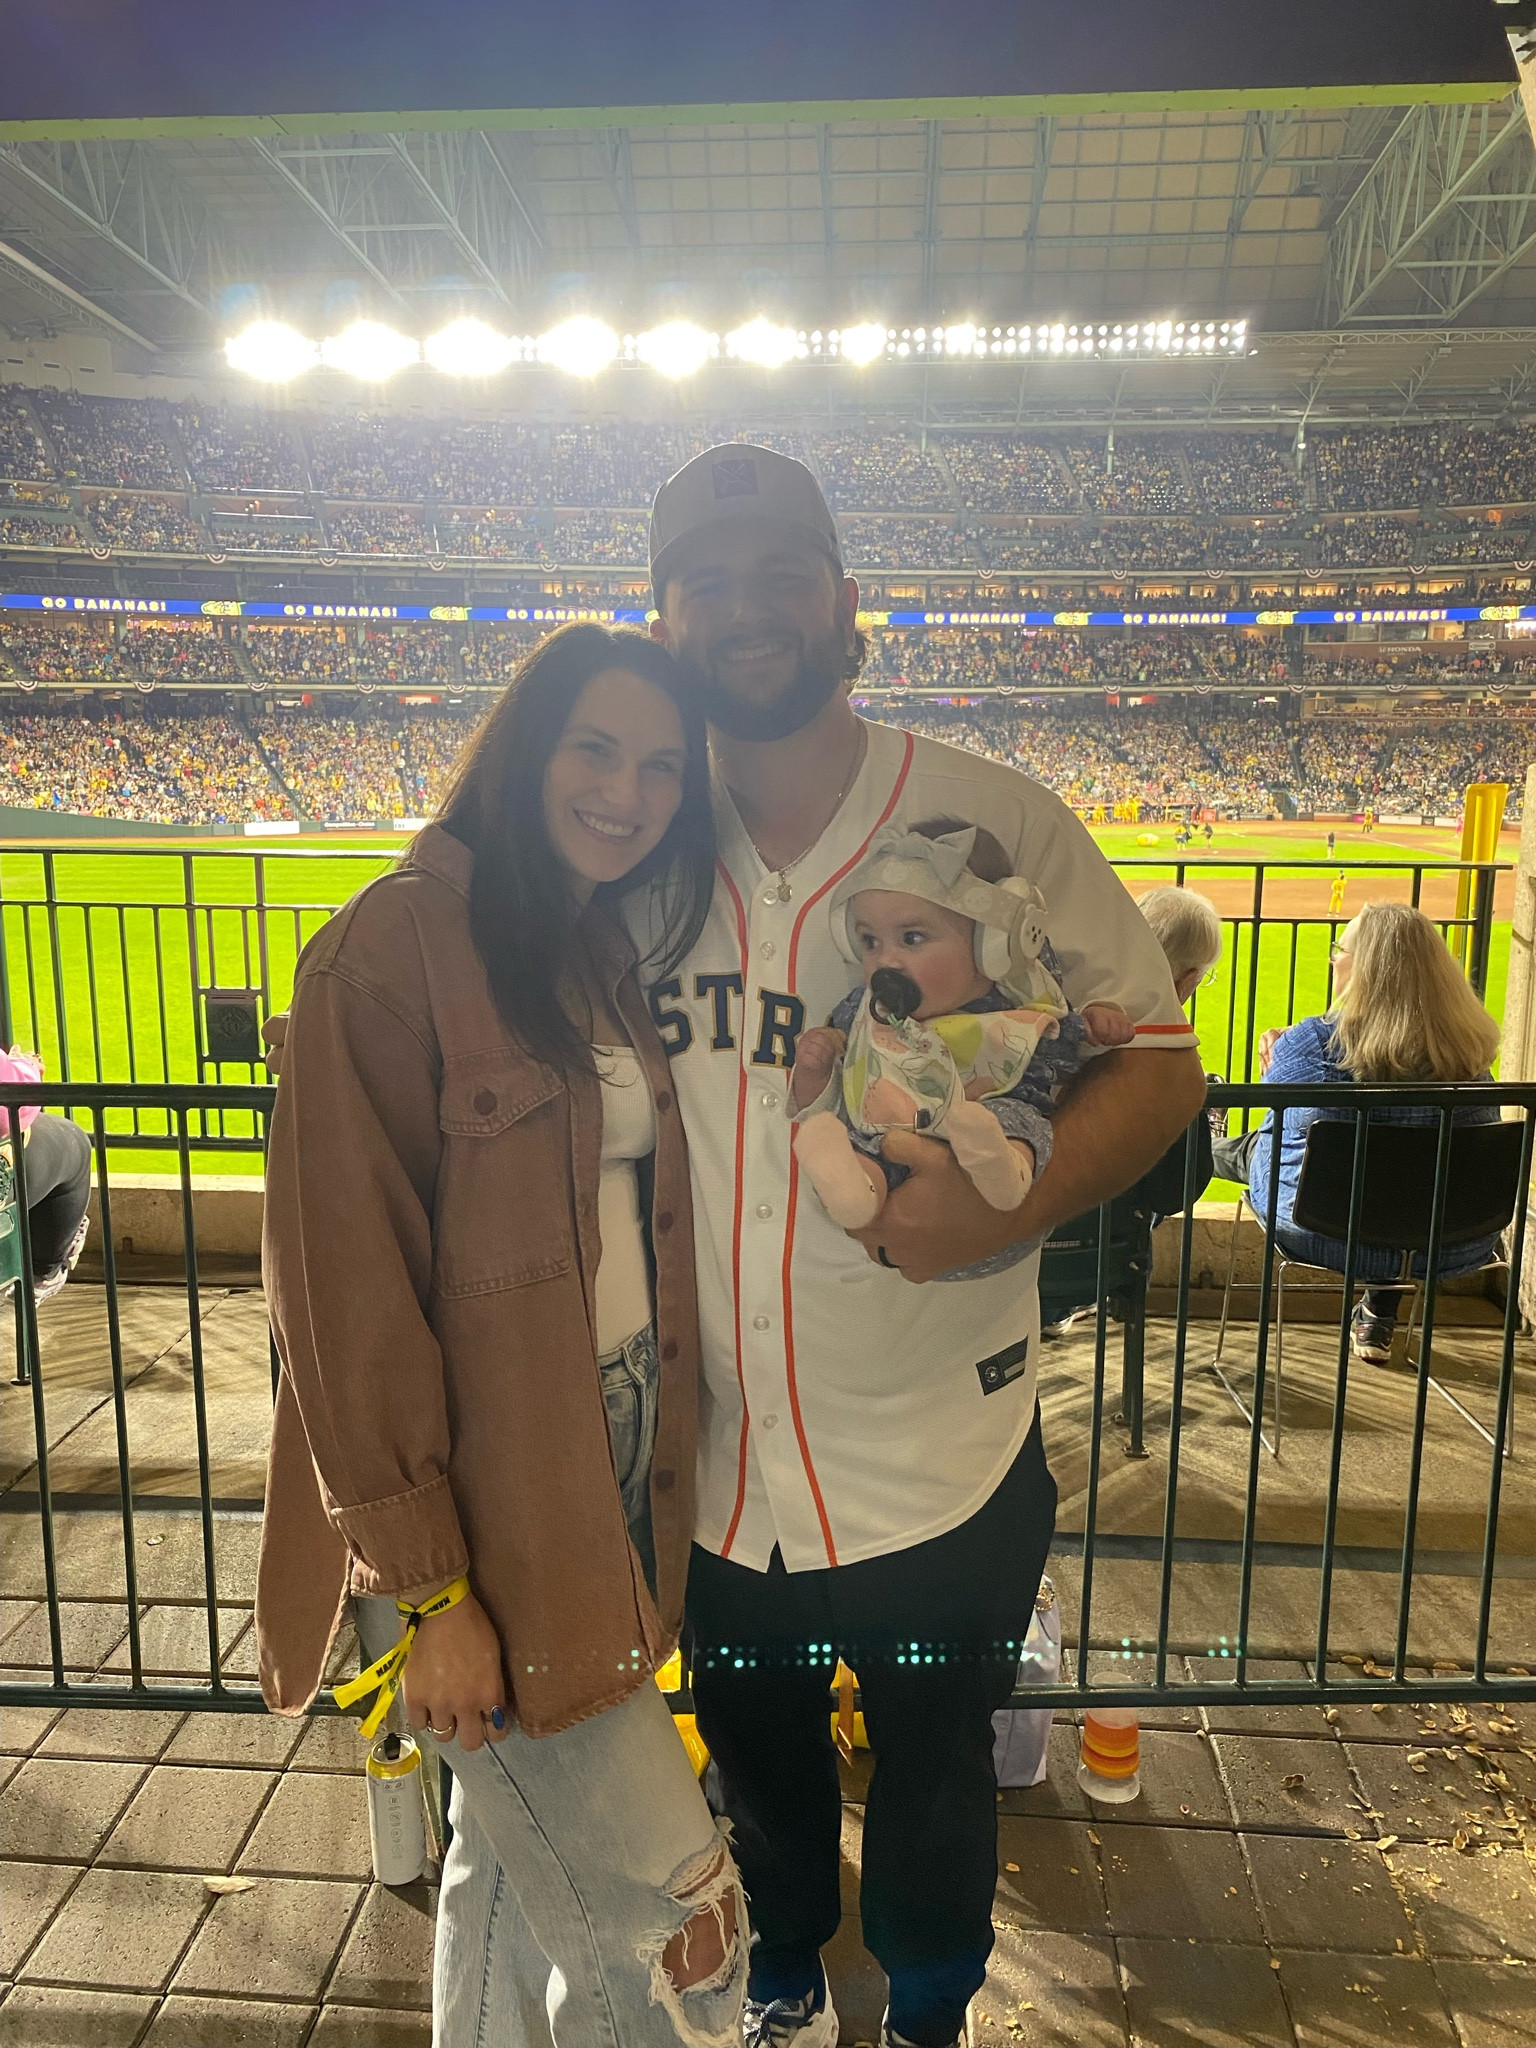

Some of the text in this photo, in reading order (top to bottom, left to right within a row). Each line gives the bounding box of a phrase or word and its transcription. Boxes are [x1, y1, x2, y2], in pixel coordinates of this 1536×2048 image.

[41, 597, 166, 612] GO BANANAS!
[283, 604, 398, 617] GO BANANAS!
[506, 608, 528, 620] GO
[924, 613, 1026, 624] GO BANANAS!
[1122, 613, 1227, 624] GO BANANAS!
[1333, 609, 1448, 622] GO BANANAS!
[649, 970, 807, 1070] STR
